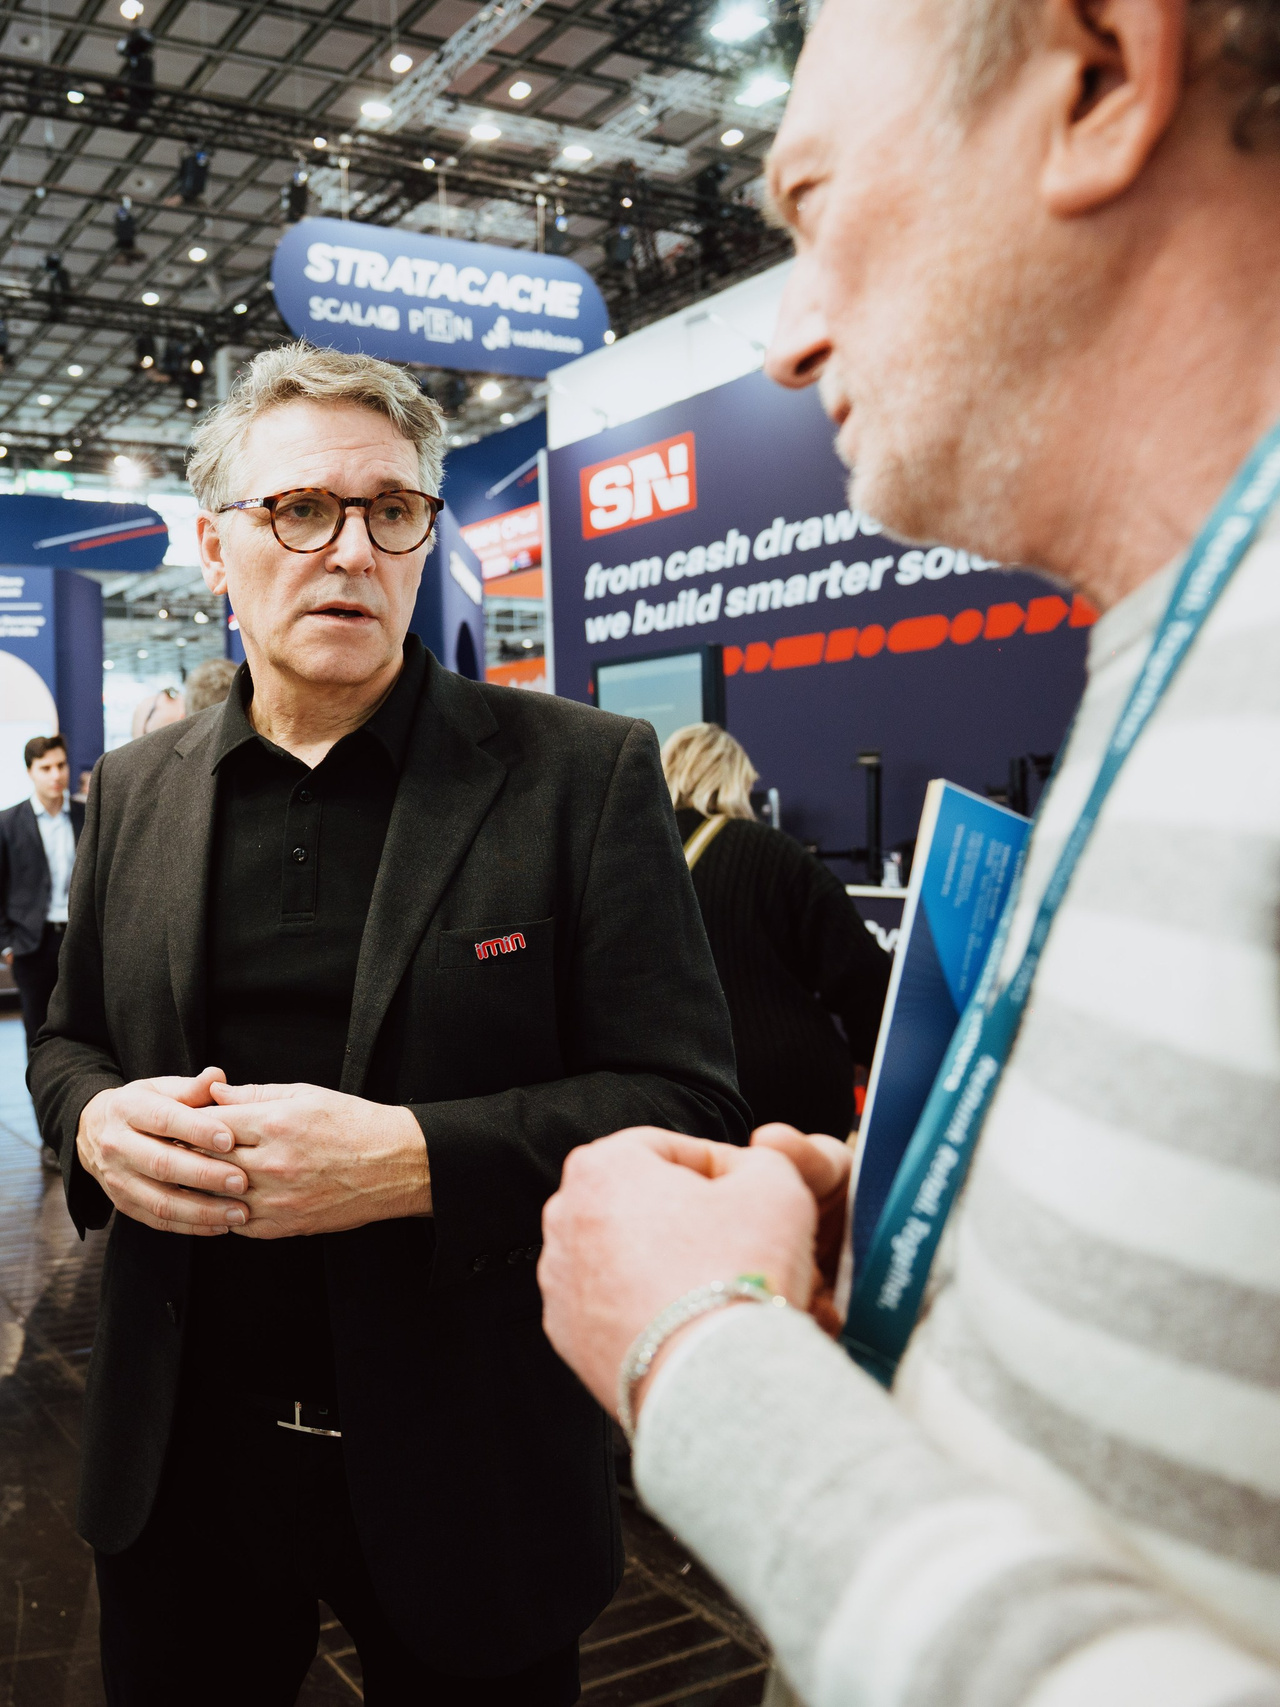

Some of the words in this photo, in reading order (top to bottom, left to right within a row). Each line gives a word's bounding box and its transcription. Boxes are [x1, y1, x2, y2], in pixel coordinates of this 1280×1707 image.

[303, 242, 583, 320] STRATACACHE
[585, 555, 663, 601] from
[664, 528, 751, 582] cash
[585, 610, 631, 644] we
[632, 583, 724, 636] build
[724, 555, 895, 618] smarter
[475, 932, 526, 960] imin
